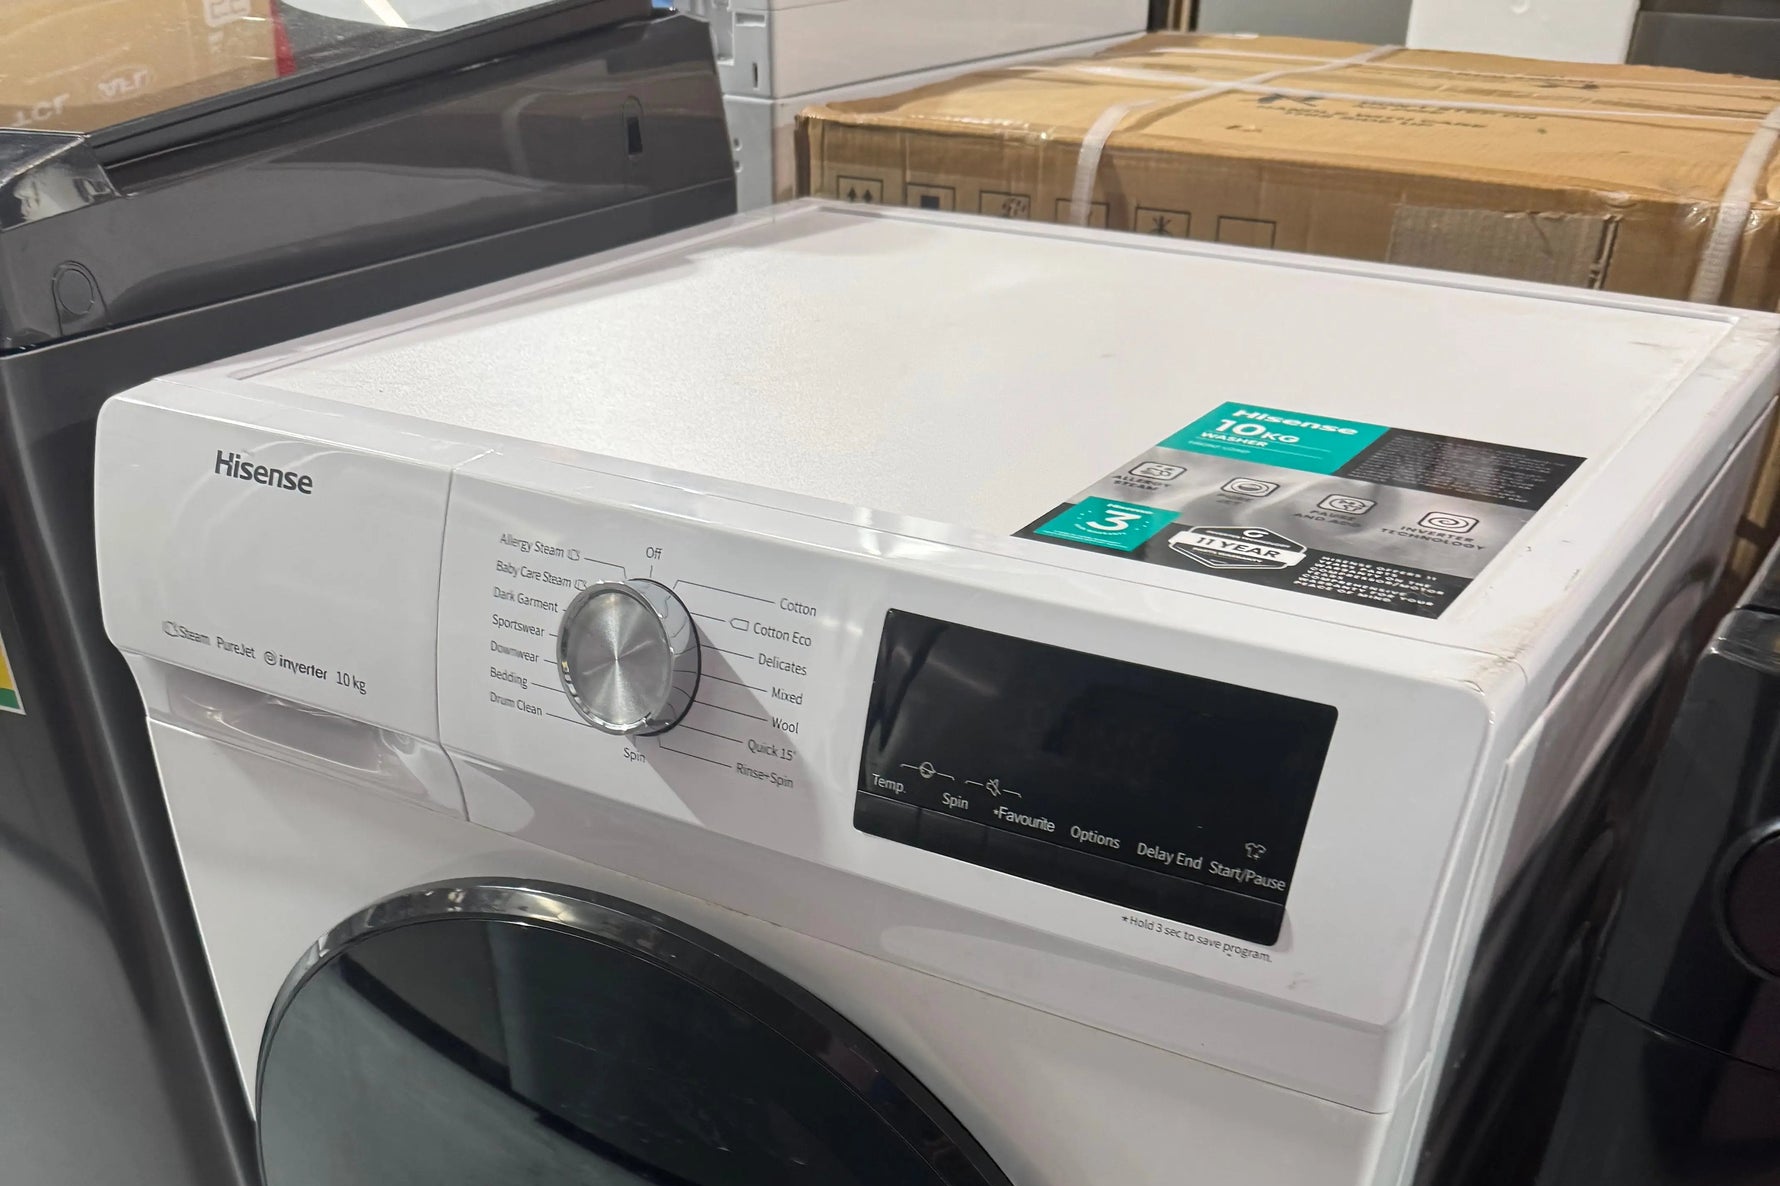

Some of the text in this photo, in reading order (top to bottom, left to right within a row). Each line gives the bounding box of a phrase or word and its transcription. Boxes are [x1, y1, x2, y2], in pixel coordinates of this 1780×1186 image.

[1232, 410, 1359, 434] Hisense
[1199, 432, 1268, 446] WASHER
[214, 449, 313, 495] Hisense
[1086, 509, 1142, 531] 3
[499, 533, 564, 558] Allergy Steam
[1381, 528, 1484, 550] TECHNOLOGY
[1401, 526, 1473, 542] INVERTER
[645, 546, 663, 561] Off
[1219, 541, 1281, 558] YEAR
[496, 560, 572, 588] Baby Care Steam
[493, 586, 558, 613] Dark Garment
[780, 597, 817, 617] Cotton
[492, 613, 545, 637] Sportswear
[753, 622, 812, 647] Cotton Eco
[178, 625, 367, 695] Steam PureJet inverter 10 kg
[758, 652, 807, 676] Delicates
[490, 667, 528, 690] Bedding
[771, 686, 803, 706] Mixed
[516, 700, 543, 716] Clean
[771, 716, 799, 734] Wool
[623, 747, 647, 764] Spin
[748, 738, 778, 757] Quick
[942, 792, 969, 811] Spin
[1070, 825, 1121, 849] Options
[1137, 842, 1204, 870] Delay End
[1208, 861, 1287, 891] Start/Pause
[1129, 915, 1154, 932] Hold
[1155, 923, 1164, 934] 3
[1163, 927, 1182, 939] sec
[1183, 931, 1196, 942] to
[1196, 935, 1222, 949] save
